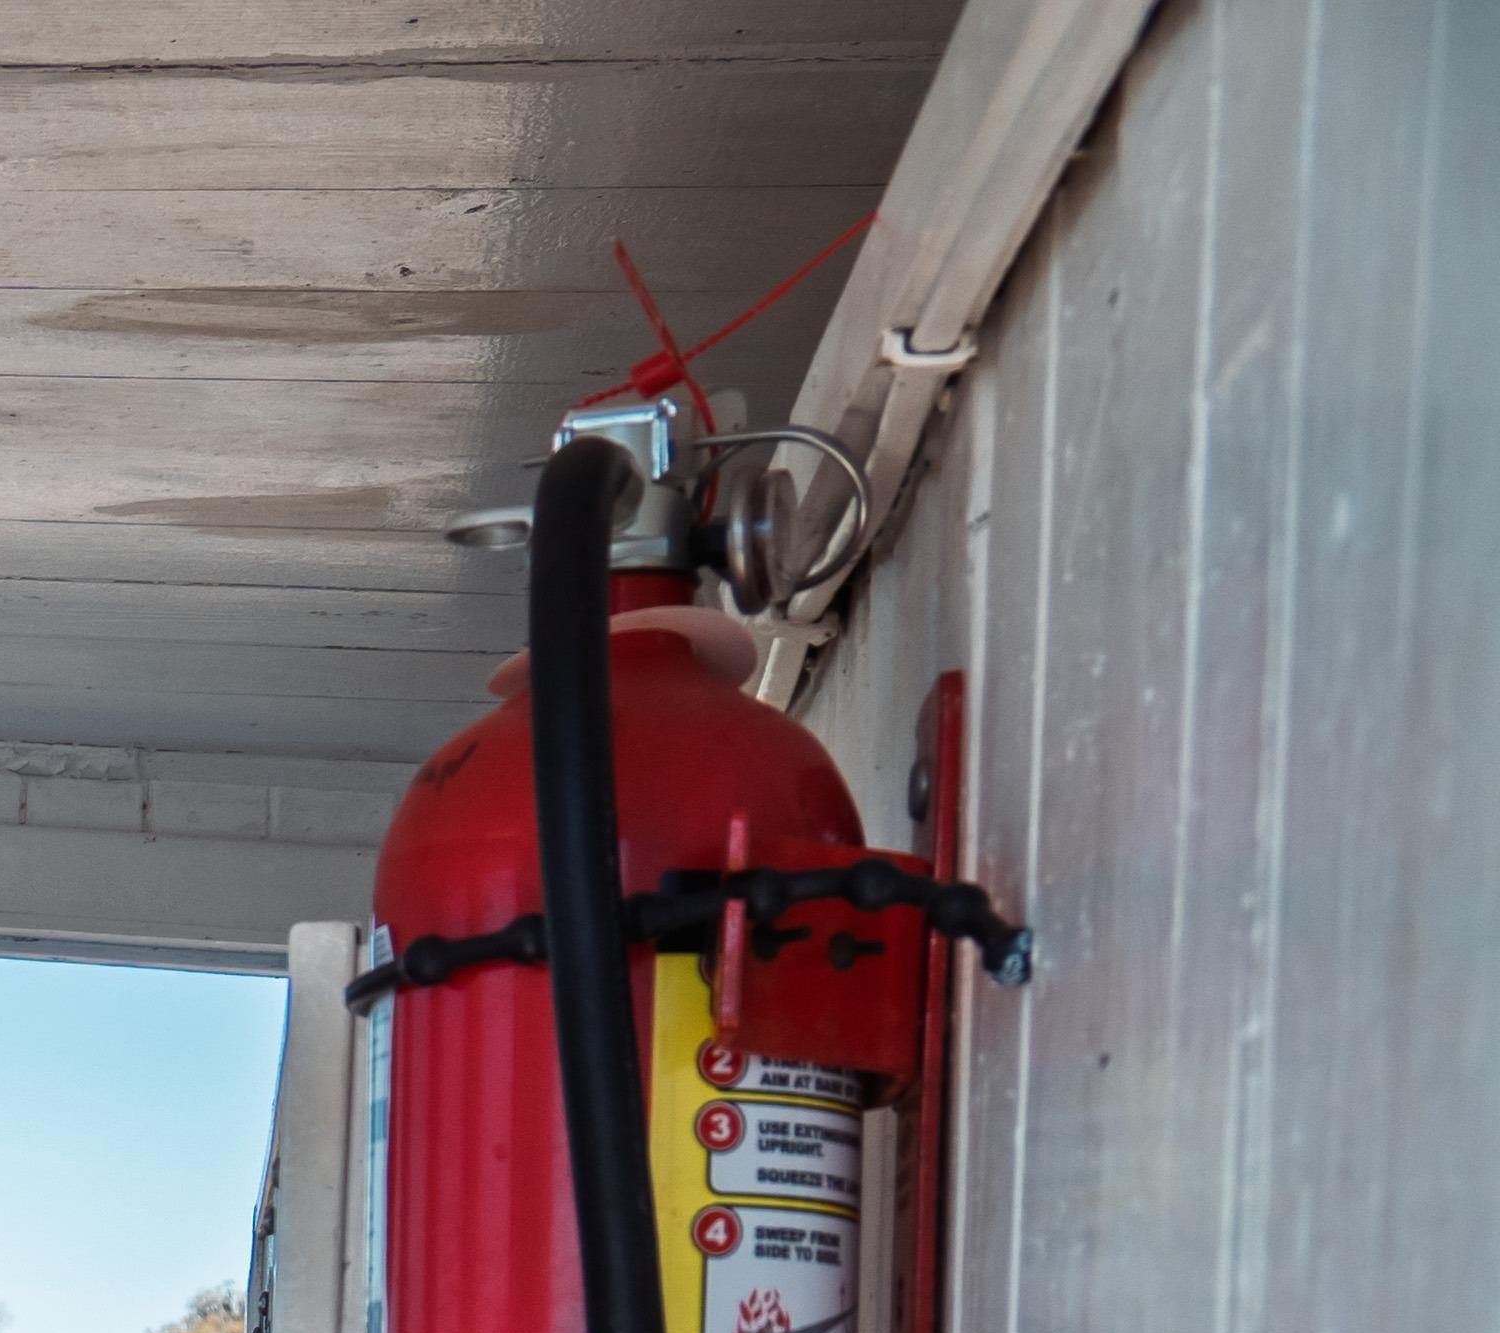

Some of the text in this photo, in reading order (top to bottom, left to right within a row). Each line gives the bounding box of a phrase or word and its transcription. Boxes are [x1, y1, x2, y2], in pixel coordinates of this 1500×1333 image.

[712, 1047, 733, 1074] 2
[760, 1072, 789, 1086] AIM
[795, 1074, 811, 1088] AT
[710, 1113, 731, 1141] 3
[758, 1120, 789, 1135] USE
[757, 1167, 822, 1187] SQUEEZE
[705, 1218, 728, 1245] 4
[755, 1226, 840, 1247] SWEEP FROM
[754, 1243, 789, 1259] SIDE
[795, 1246, 813, 1262] TO
